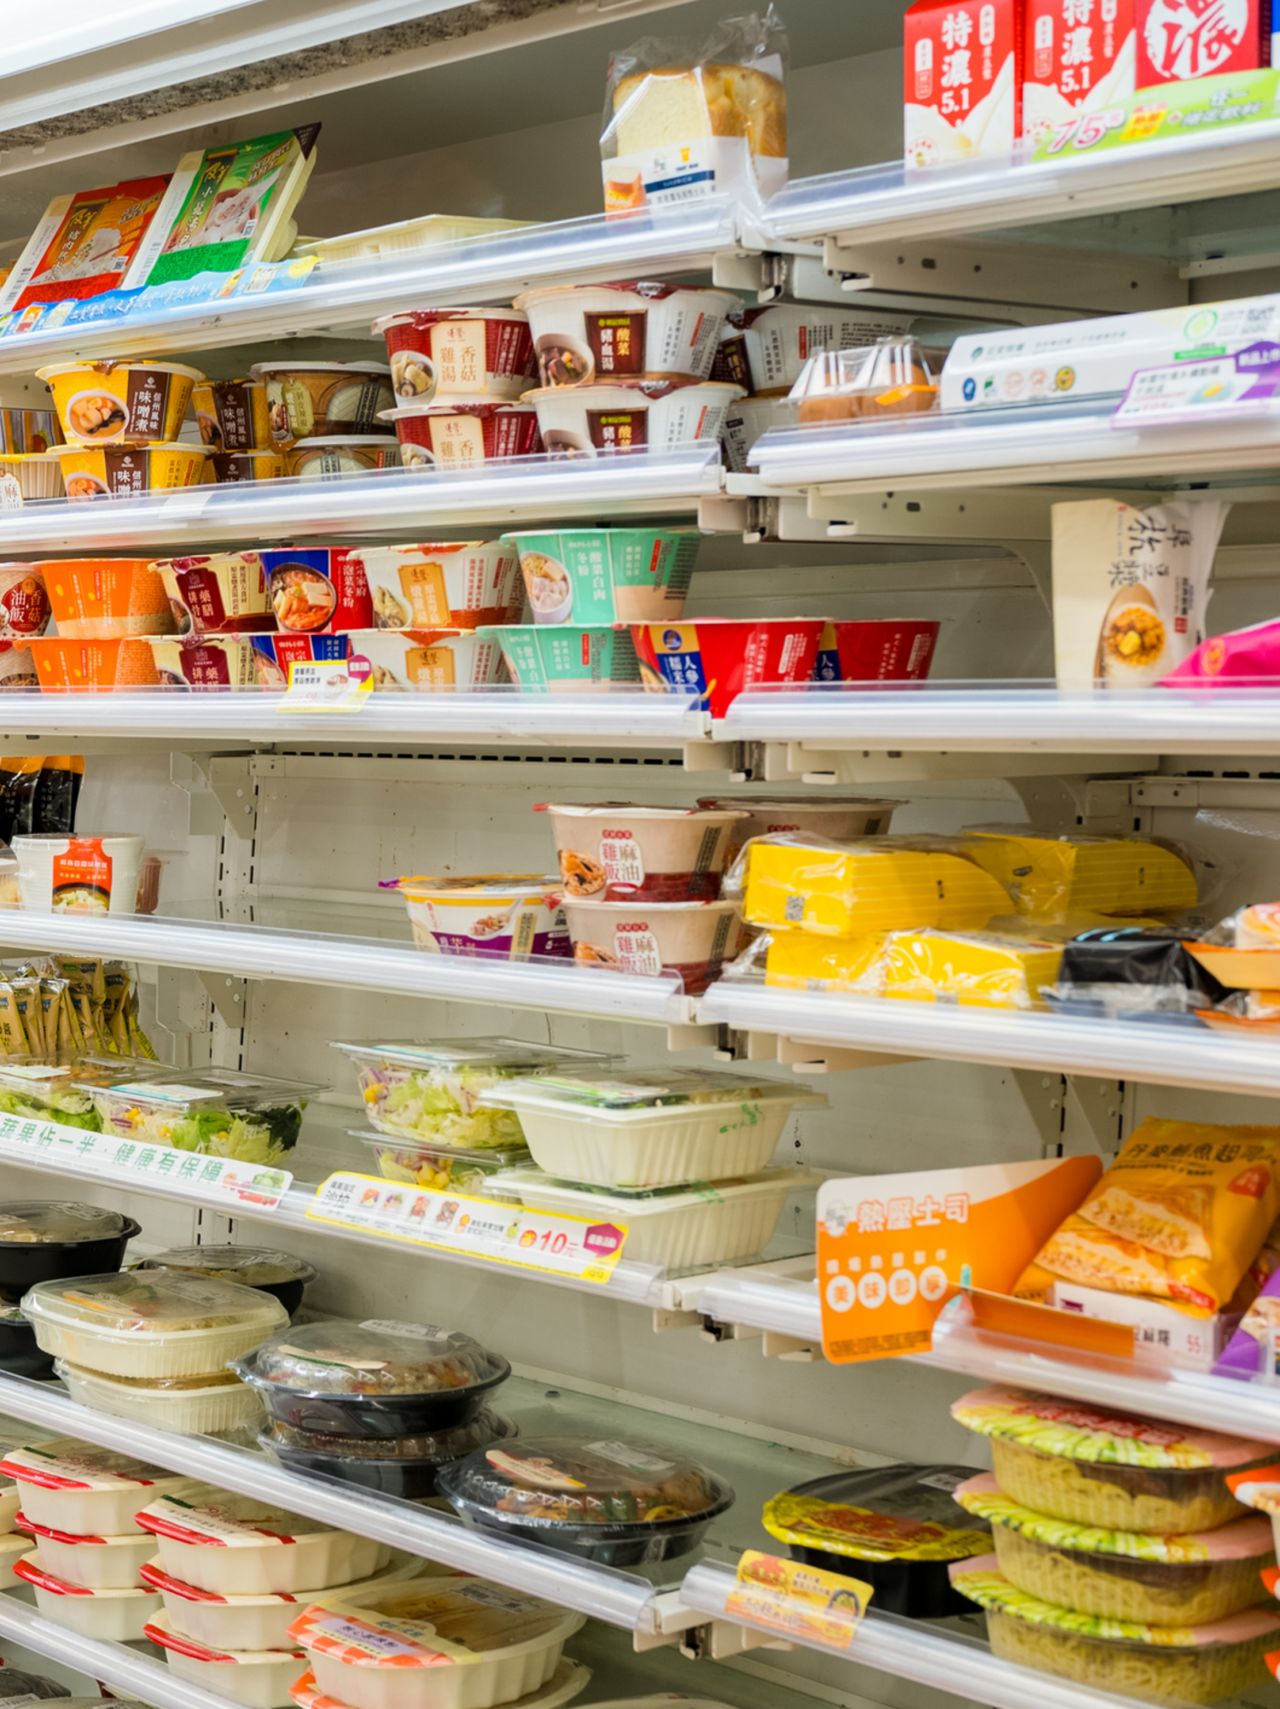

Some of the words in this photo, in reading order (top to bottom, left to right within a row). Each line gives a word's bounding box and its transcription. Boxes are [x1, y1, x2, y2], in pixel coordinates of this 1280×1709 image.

[1061, 66, 1091, 93] 5.1
[941, 88, 970, 114] 5.1
[440, 347, 457, 383] 雞湯
[460, 345, 477, 382] 香菇
[135, 390, 152, 433] 味噌煮
[149, 392, 162, 431] 信州風味
[589, 551, 606, 601] 酸菜白肉
[9, 589, 27, 624] 油飯
[28, 590, 43, 624] 香菇
[619, 842, 642, 884] 麻油
[856, 1192, 970, 1234] 熱壓土司
